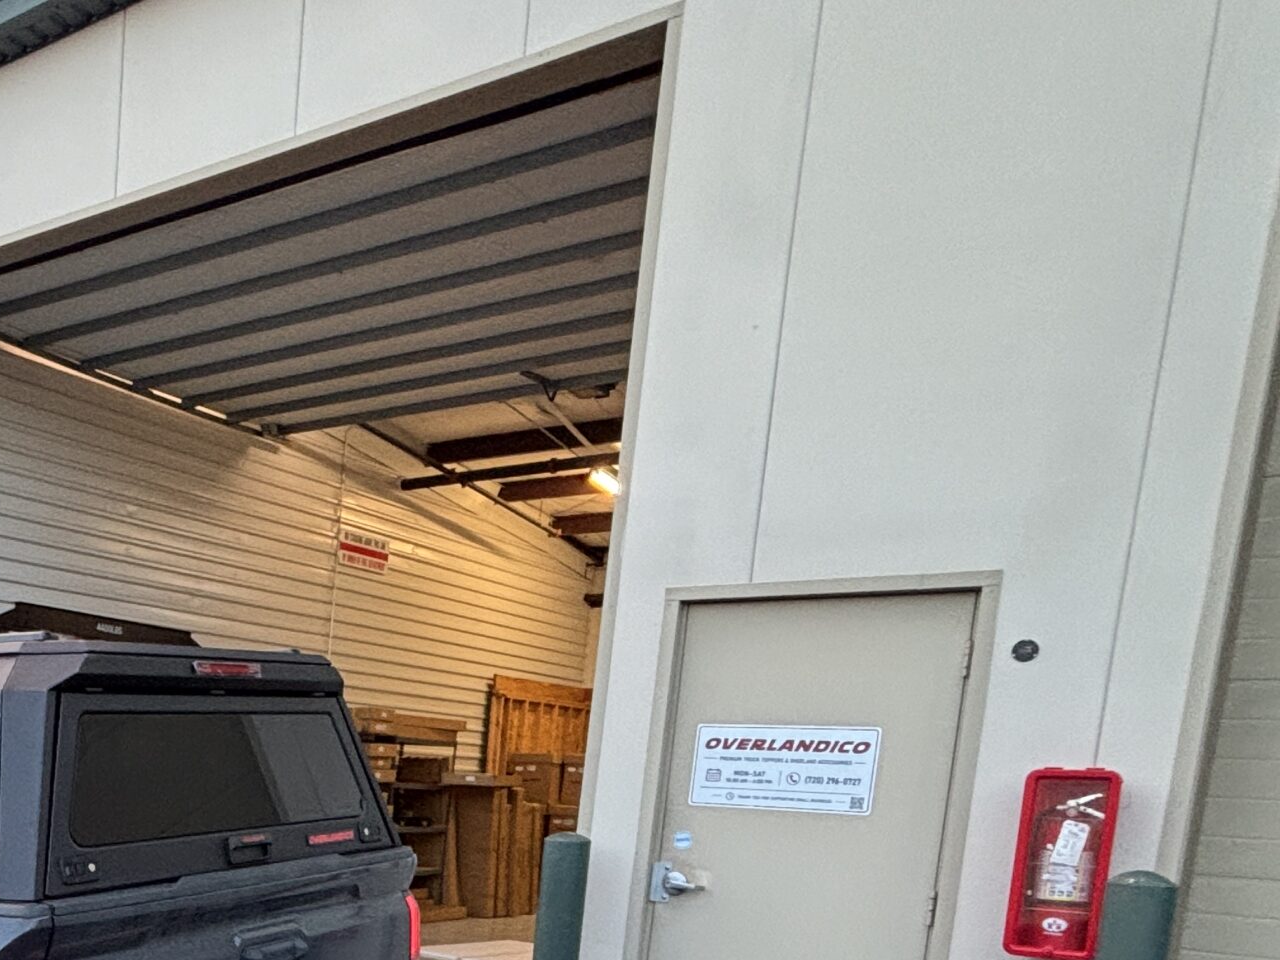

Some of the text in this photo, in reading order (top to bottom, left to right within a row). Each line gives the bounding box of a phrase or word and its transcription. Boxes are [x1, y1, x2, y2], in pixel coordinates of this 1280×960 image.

[705, 738, 872, 754] OVERLANDICO
[804, 776, 862, 786] (720) 296-0727
